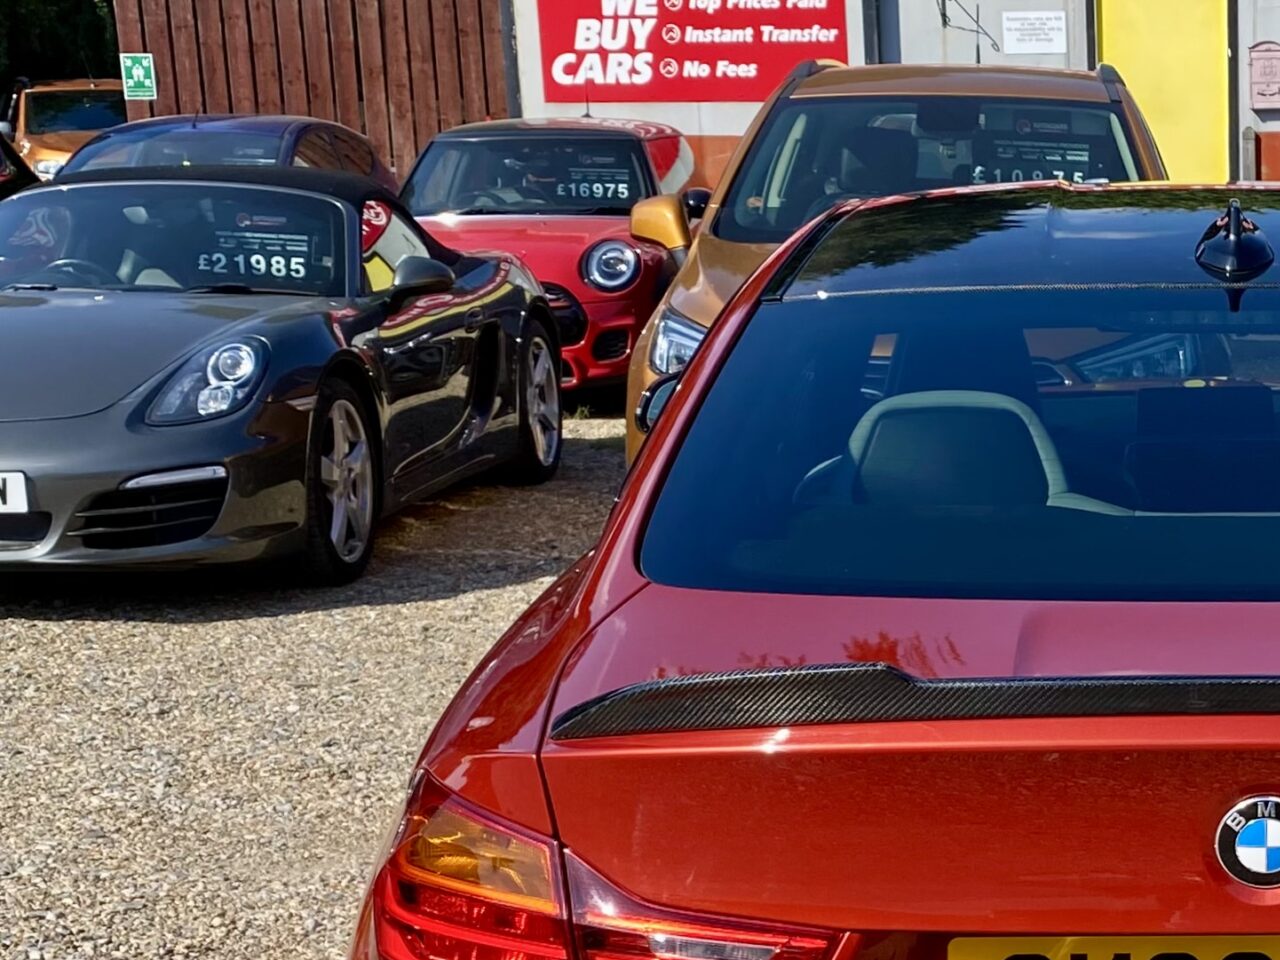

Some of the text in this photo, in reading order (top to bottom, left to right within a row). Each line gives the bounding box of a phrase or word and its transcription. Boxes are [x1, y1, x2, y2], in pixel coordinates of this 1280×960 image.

[574, 18, 657, 50] BUY
[684, 24, 839, 44] Instant Transfer
[551, 52, 654, 85] CARS
[682, 60, 758, 78] No Fees
[557, 182, 629, 199] £16975
[198, 252, 306, 278] £21985
